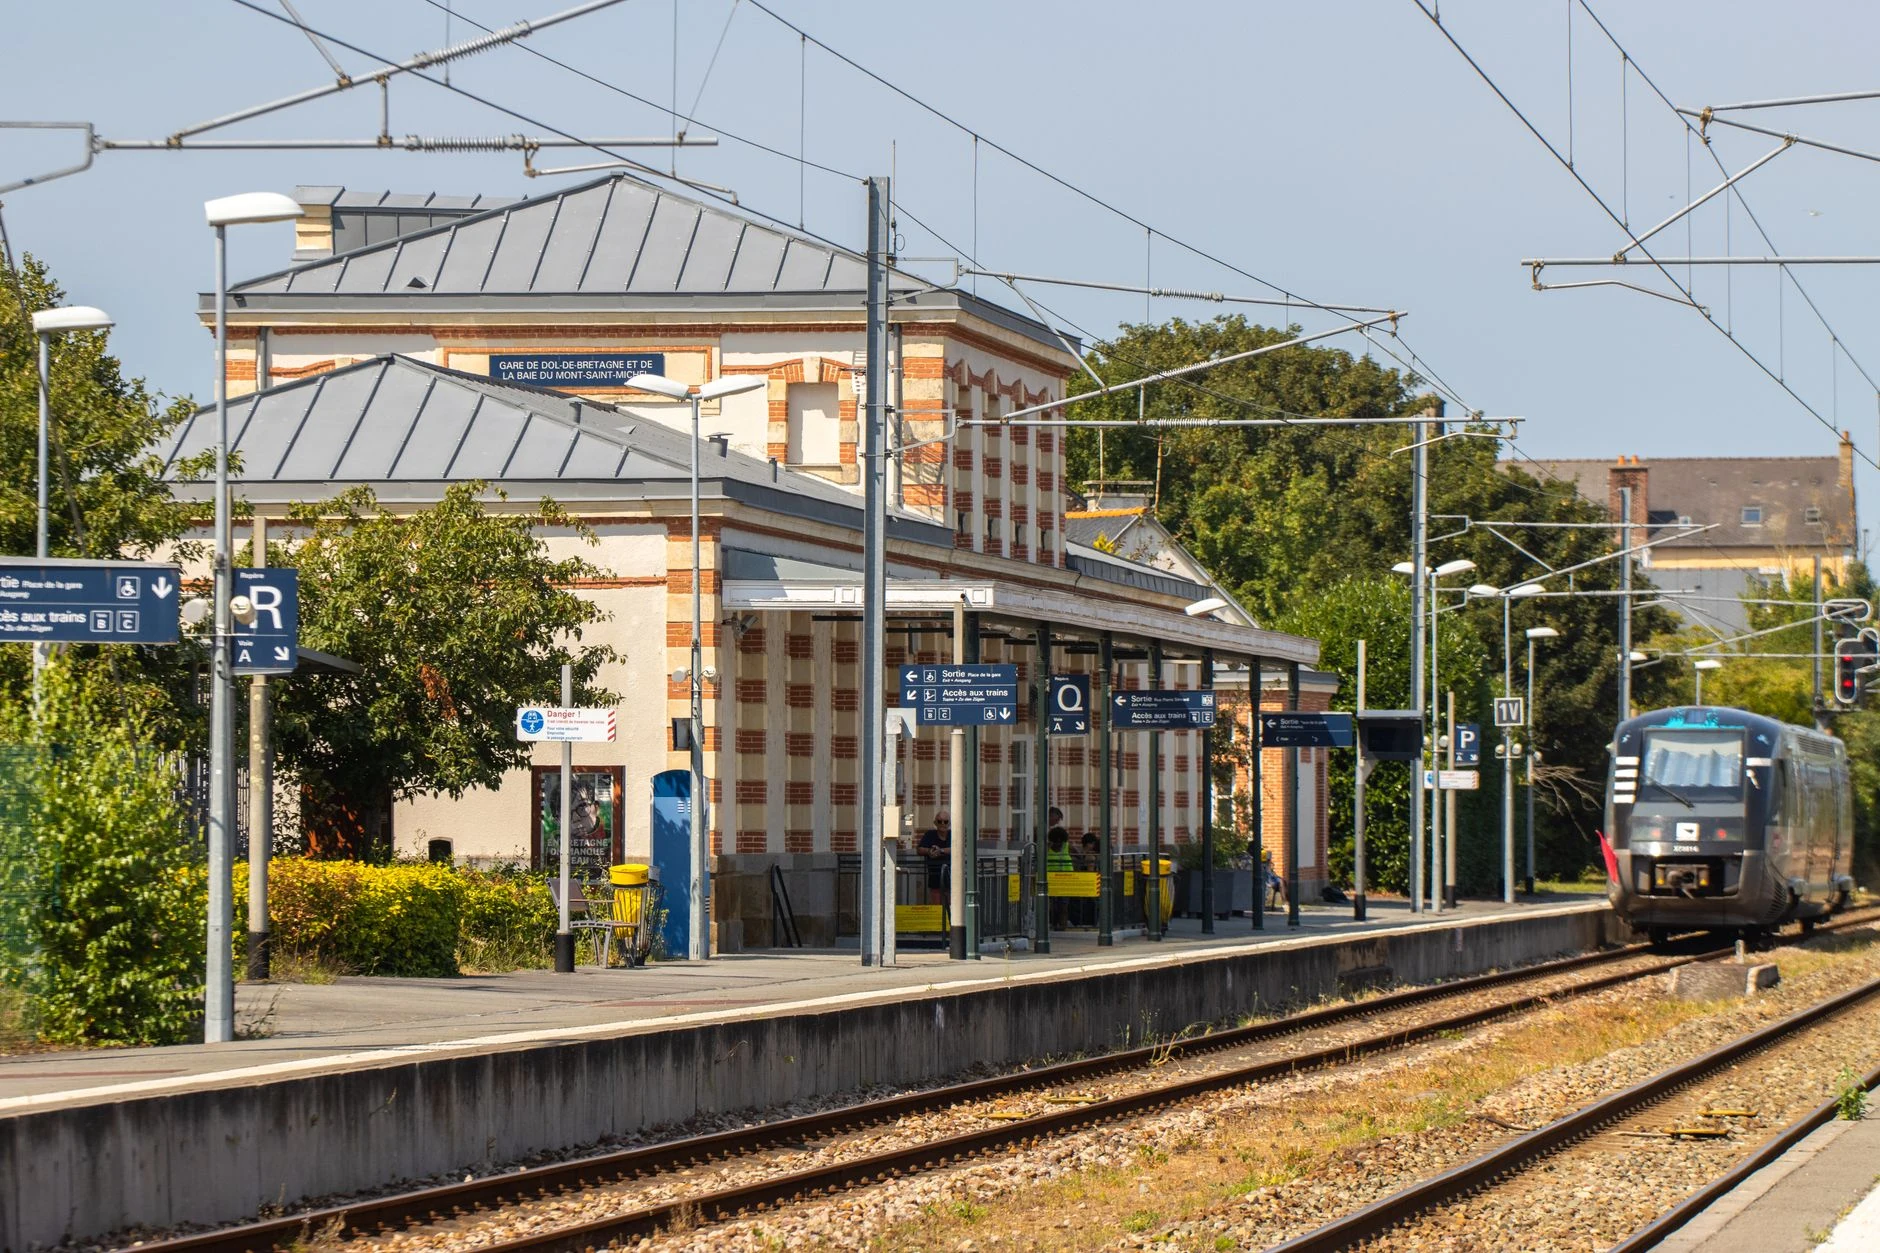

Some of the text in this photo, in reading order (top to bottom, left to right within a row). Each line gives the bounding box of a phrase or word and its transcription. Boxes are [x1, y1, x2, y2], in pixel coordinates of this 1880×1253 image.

[499, 360, 653, 370] GARE DE DOL-DE-BRETAGNE ET DE
[502, 371, 515, 380] LA
[517, 371, 537, 380] BAIE
[540, 371, 553, 380] DU
[249, 586, 283, 629] R
[21, 612, 46, 622] aux
[48, 610, 87, 623] trains
[97, 619, 106, 629] B
[123, 619, 133, 629] C
[238, 649, 252, 662] A
[942, 670, 966, 678] Sortie
[942, 689, 968, 697] Accès
[986, 689, 1009, 697] trains
[1057, 684, 1083, 712] Q
[1131, 695, 1153, 703] Sortie
[547, 711, 575, 719] Danger
[1168, 711, 1186, 719] trains
[1499, 703, 1519, 721] 1V
[1053, 722, 1062, 731] A
[1461, 731, 1475, 748] P
